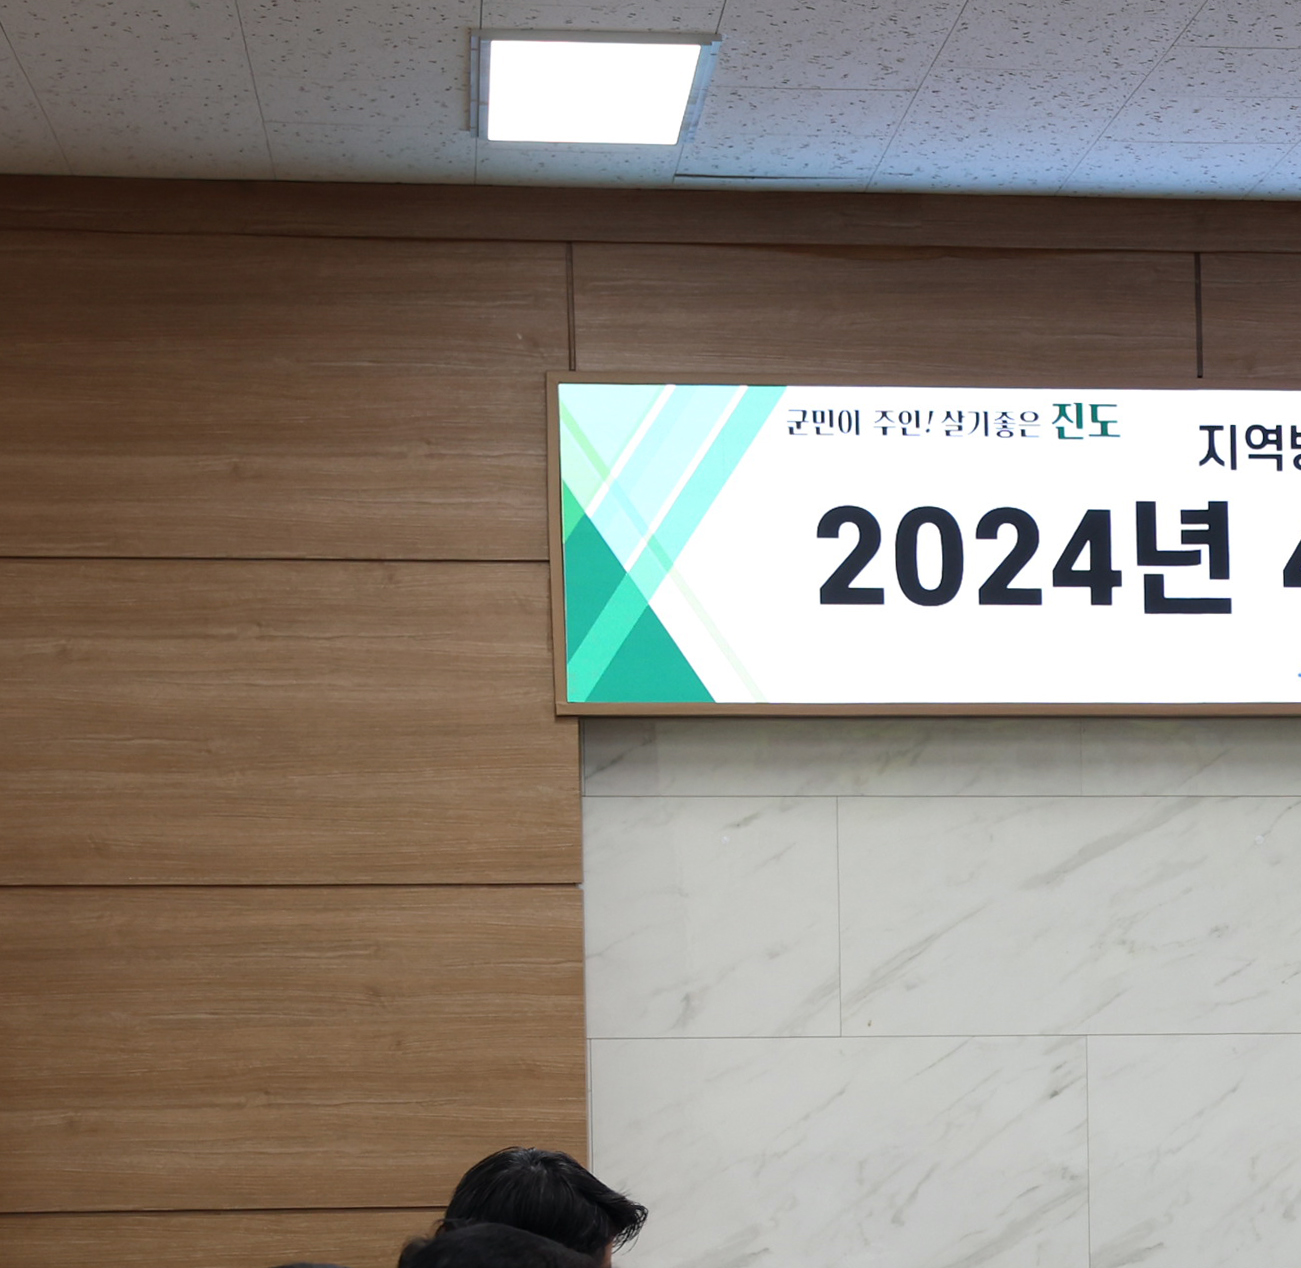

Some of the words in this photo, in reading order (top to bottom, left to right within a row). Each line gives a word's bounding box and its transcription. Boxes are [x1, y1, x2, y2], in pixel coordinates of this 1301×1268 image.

[787, 408, 861, 437] 군민이
[873, 409, 935, 437] 주인!
[941, 410, 1041, 439] 살기좋은
[1051, 402, 1121, 440] 진도
[815, 500, 1234, 616] 2024년
